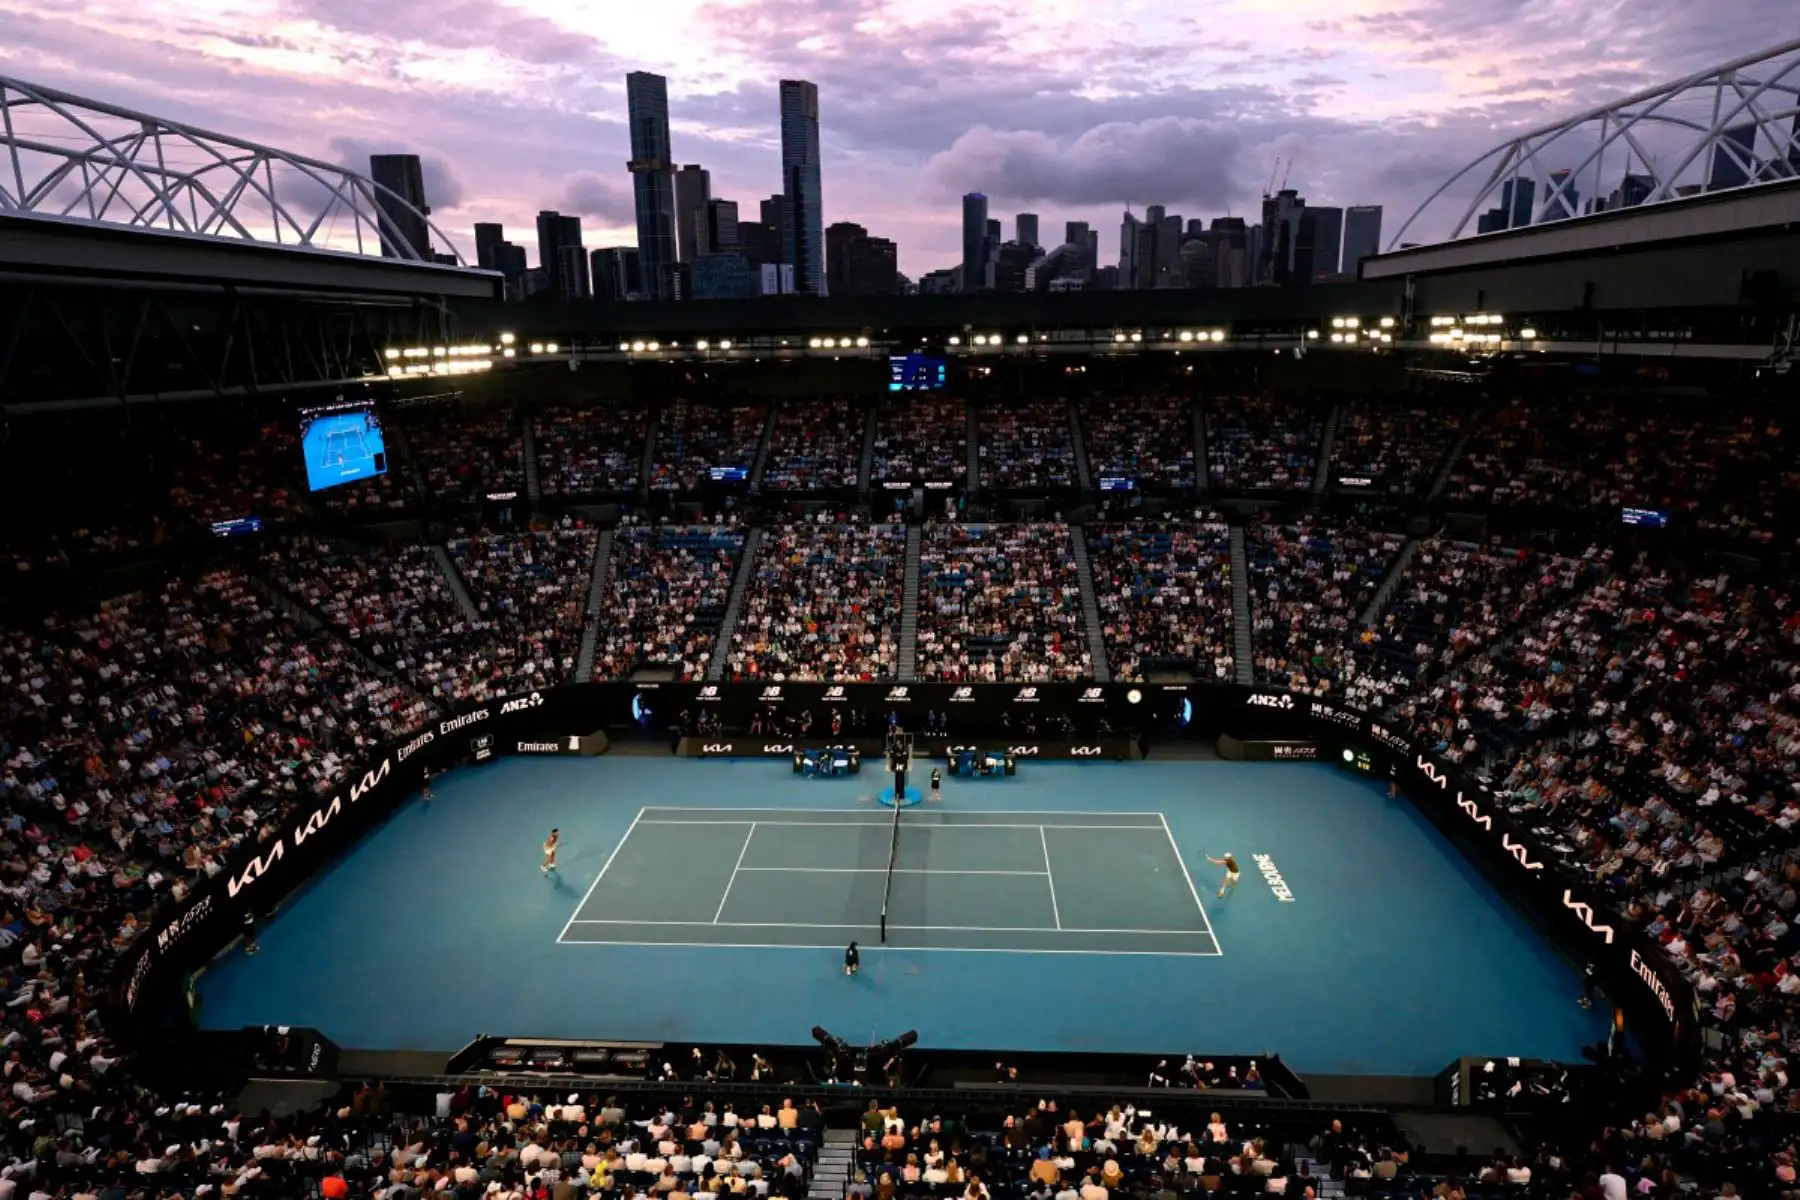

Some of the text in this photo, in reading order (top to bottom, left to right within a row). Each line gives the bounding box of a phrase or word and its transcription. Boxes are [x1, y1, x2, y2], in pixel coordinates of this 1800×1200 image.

[500, 697, 529, 715] ANZ
[1246, 694, 1279, 707] ANZ
[440, 708, 490, 735] Emirates
[517, 741, 559, 752] Emirates
[350, 758, 391, 803] KIA
[294, 796, 341, 846] KIA
[227, 839, 284, 898] KIA
